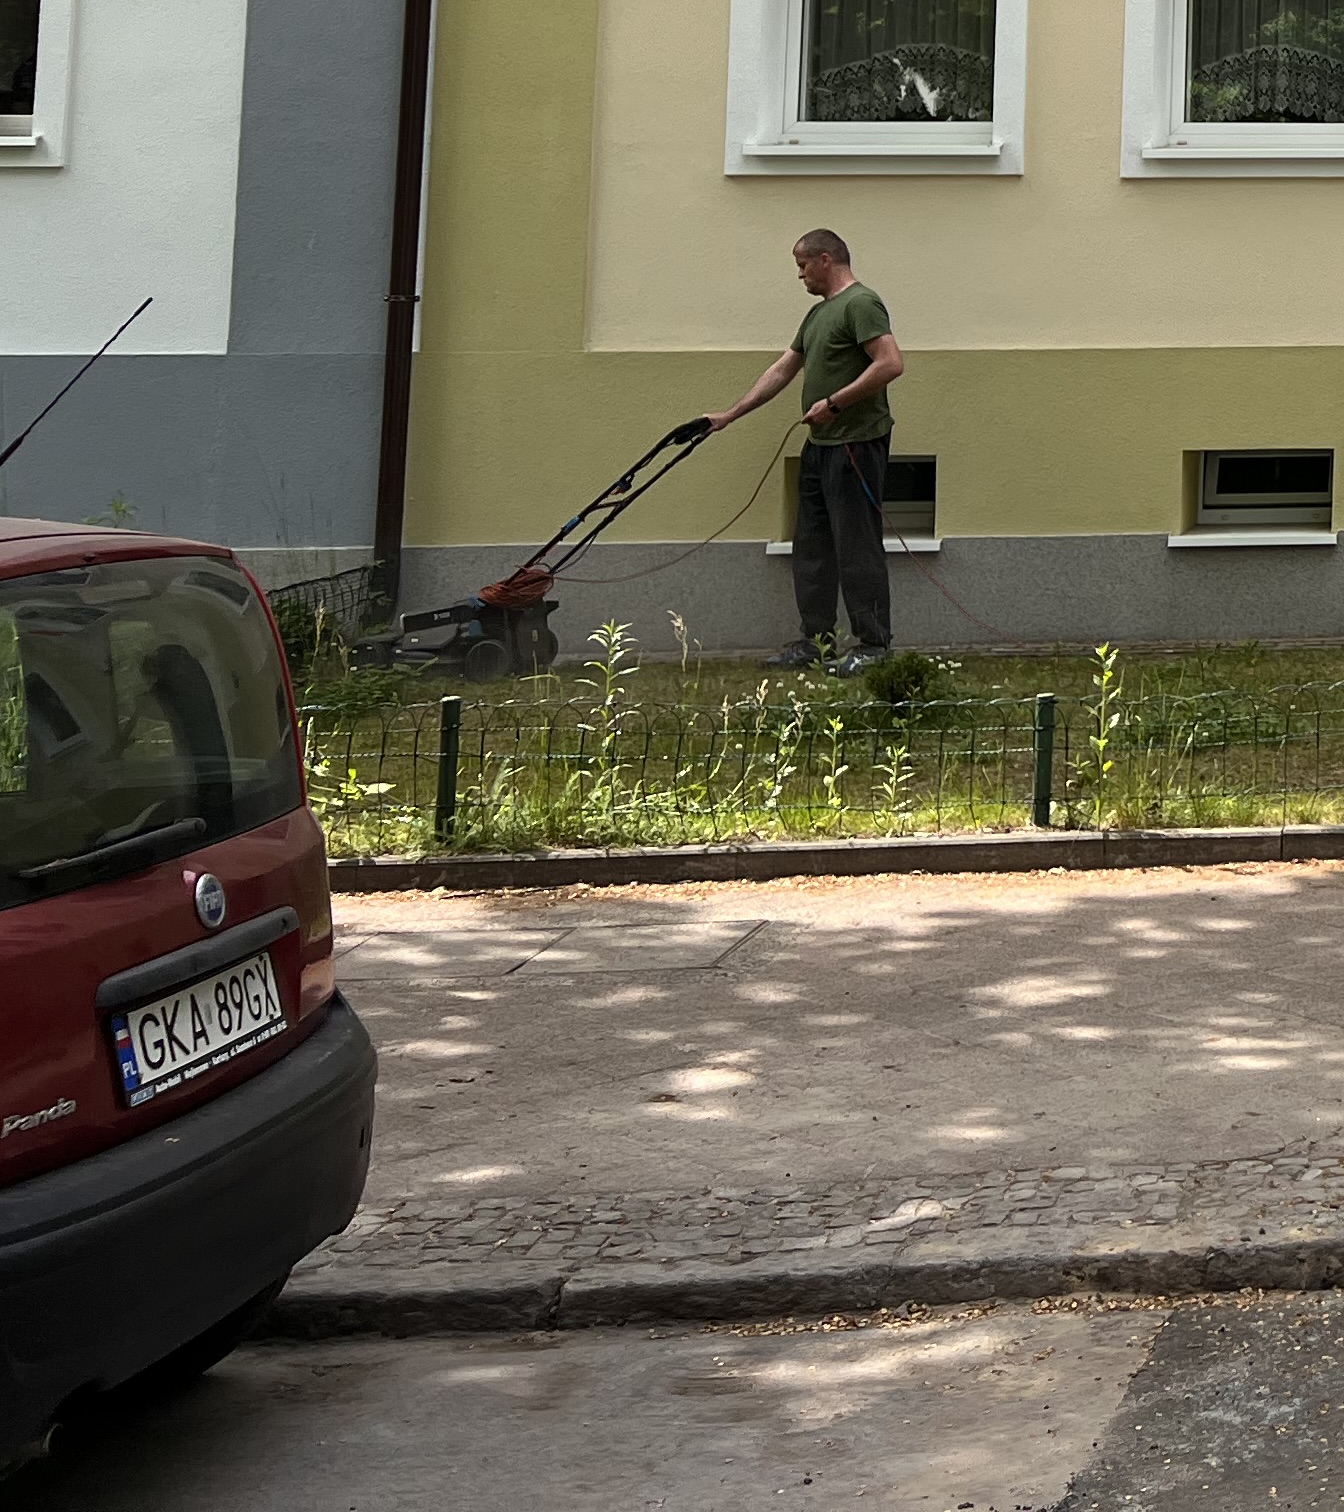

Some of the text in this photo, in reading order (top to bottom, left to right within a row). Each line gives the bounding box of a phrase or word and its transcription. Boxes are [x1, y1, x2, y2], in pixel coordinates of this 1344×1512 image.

[138, 993, 210, 1070] GKA
[215, 958, 278, 1036] 89GX
[122, 1061, 137, 1078] PL
[0, 1098, 77, 1139] Panda
